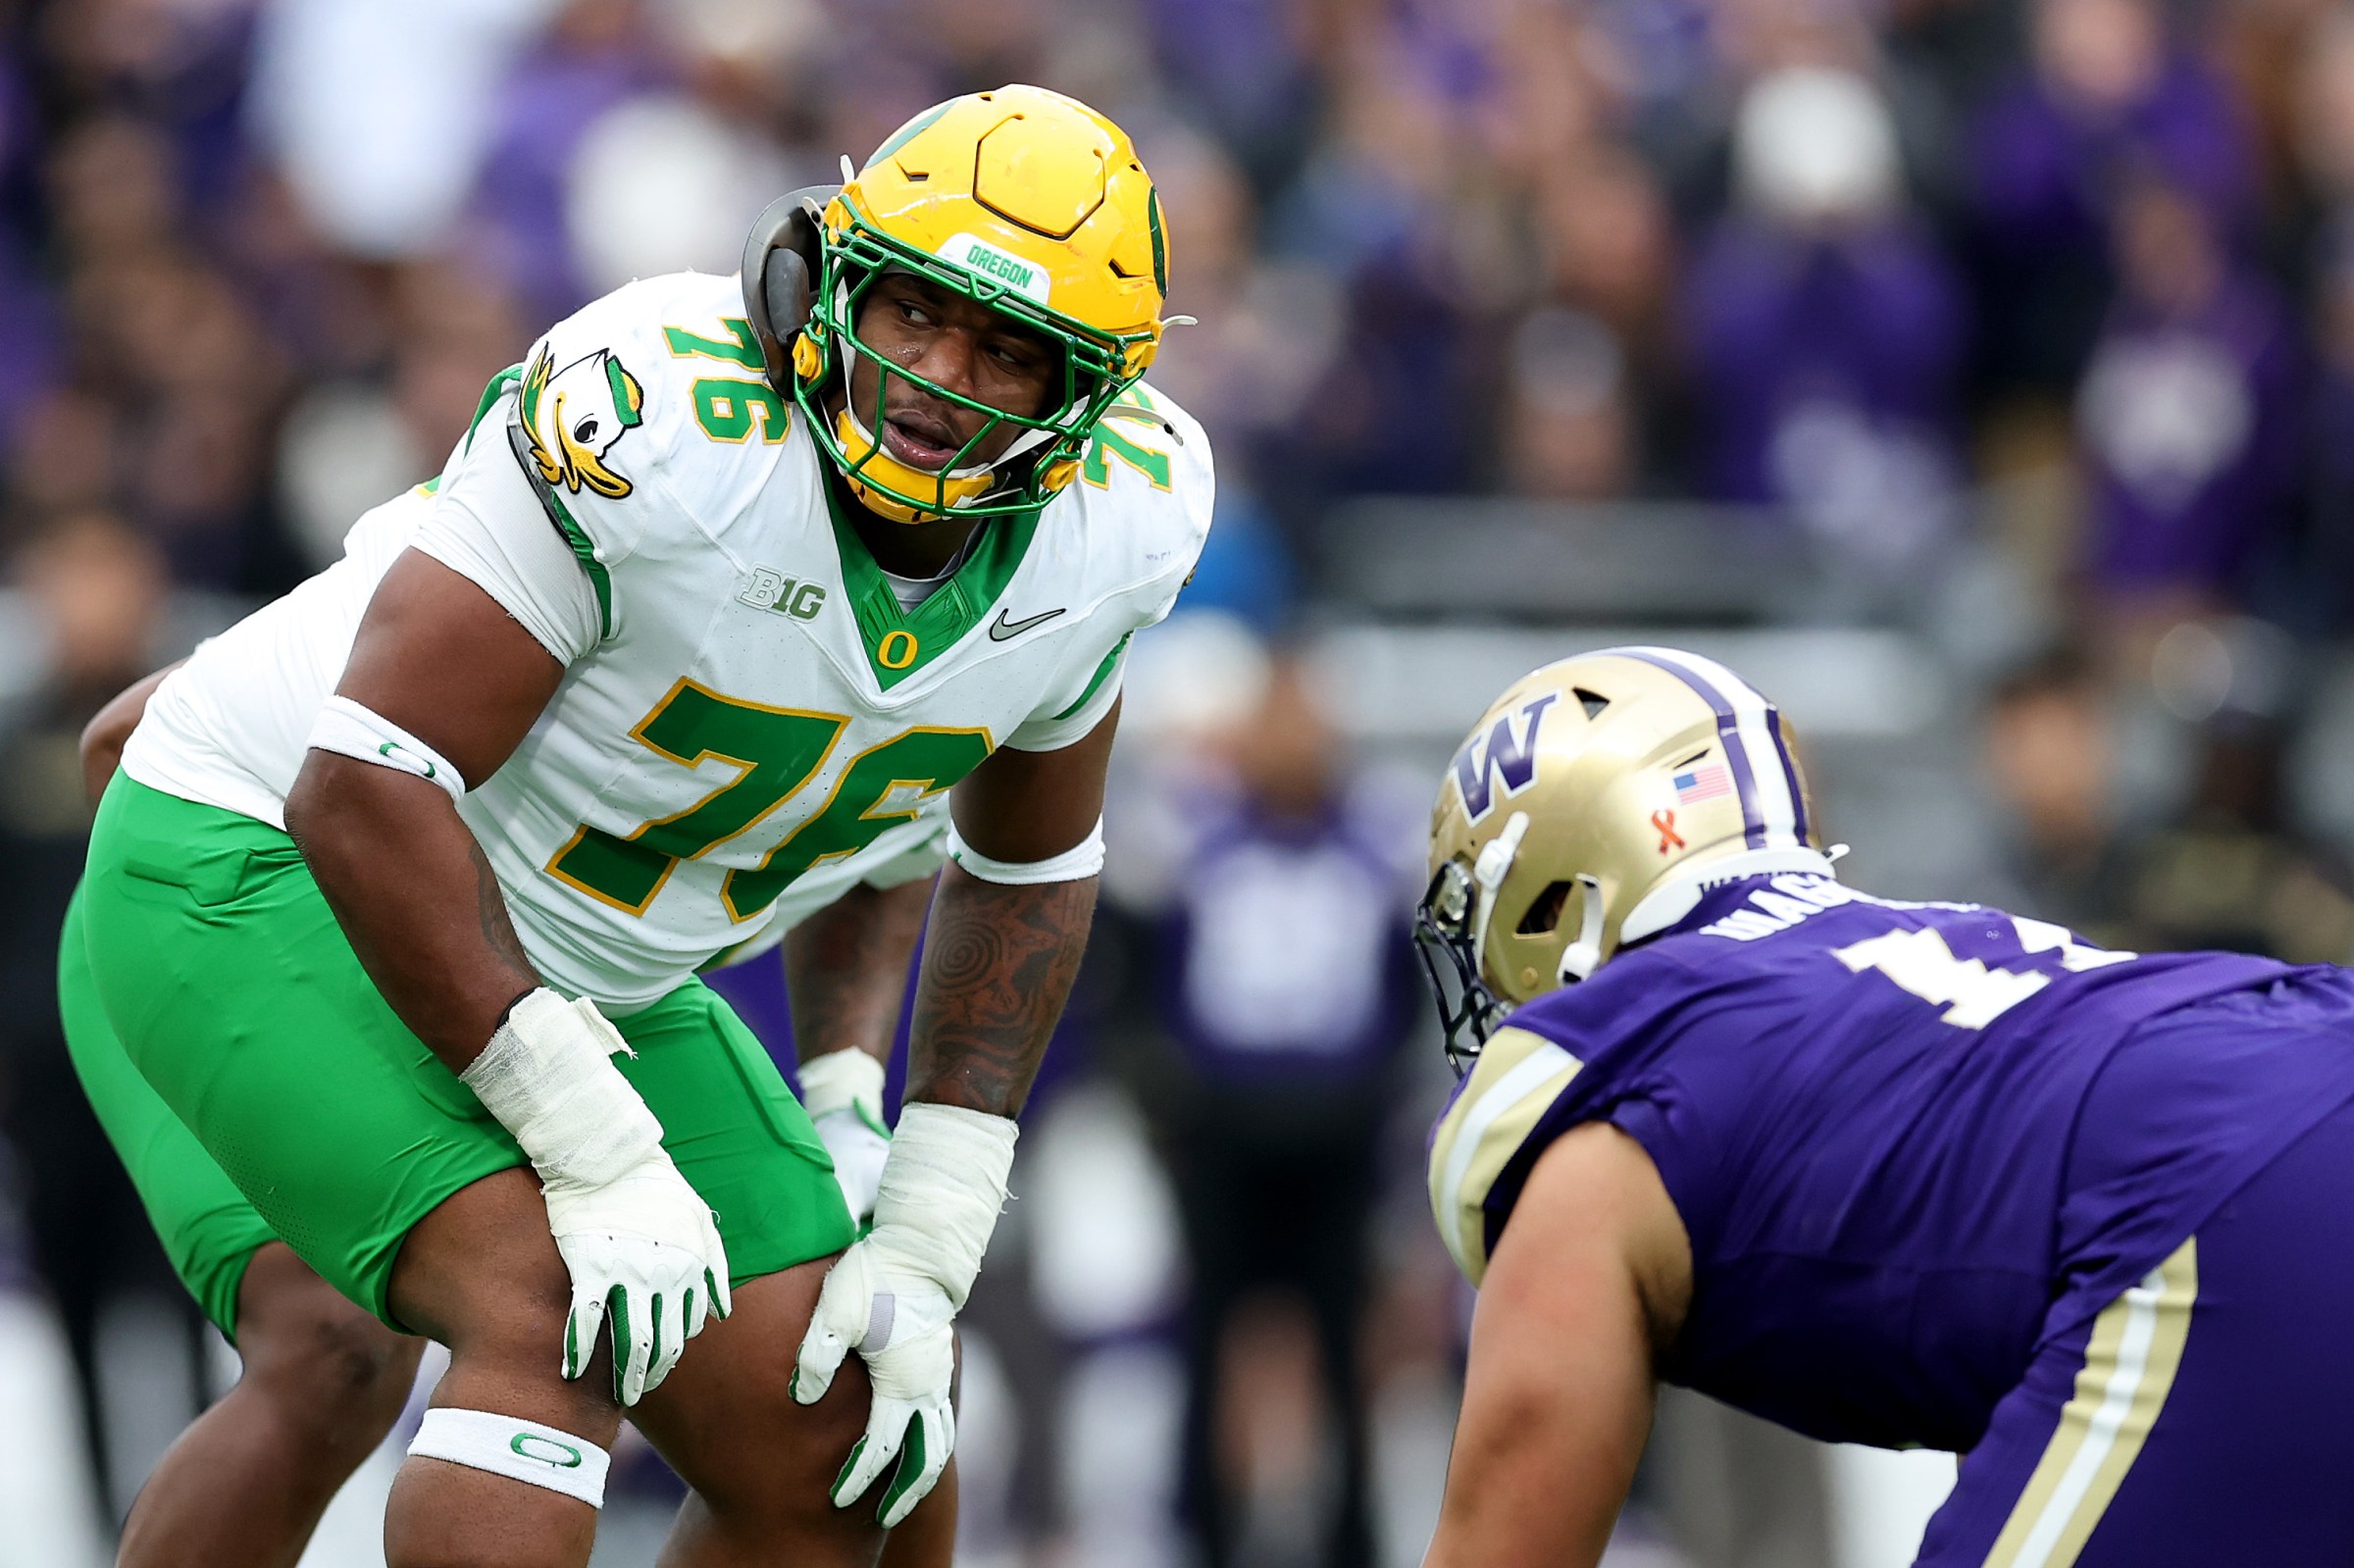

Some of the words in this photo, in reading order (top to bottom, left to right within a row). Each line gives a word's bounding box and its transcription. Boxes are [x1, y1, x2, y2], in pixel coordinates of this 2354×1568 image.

[966, 244, 1034, 288] OREGON
[662, 317, 792, 445] 76
[878, 630, 918, 670] O
[544, 677, 997, 925] 76
[1452, 689, 1560, 826] W
